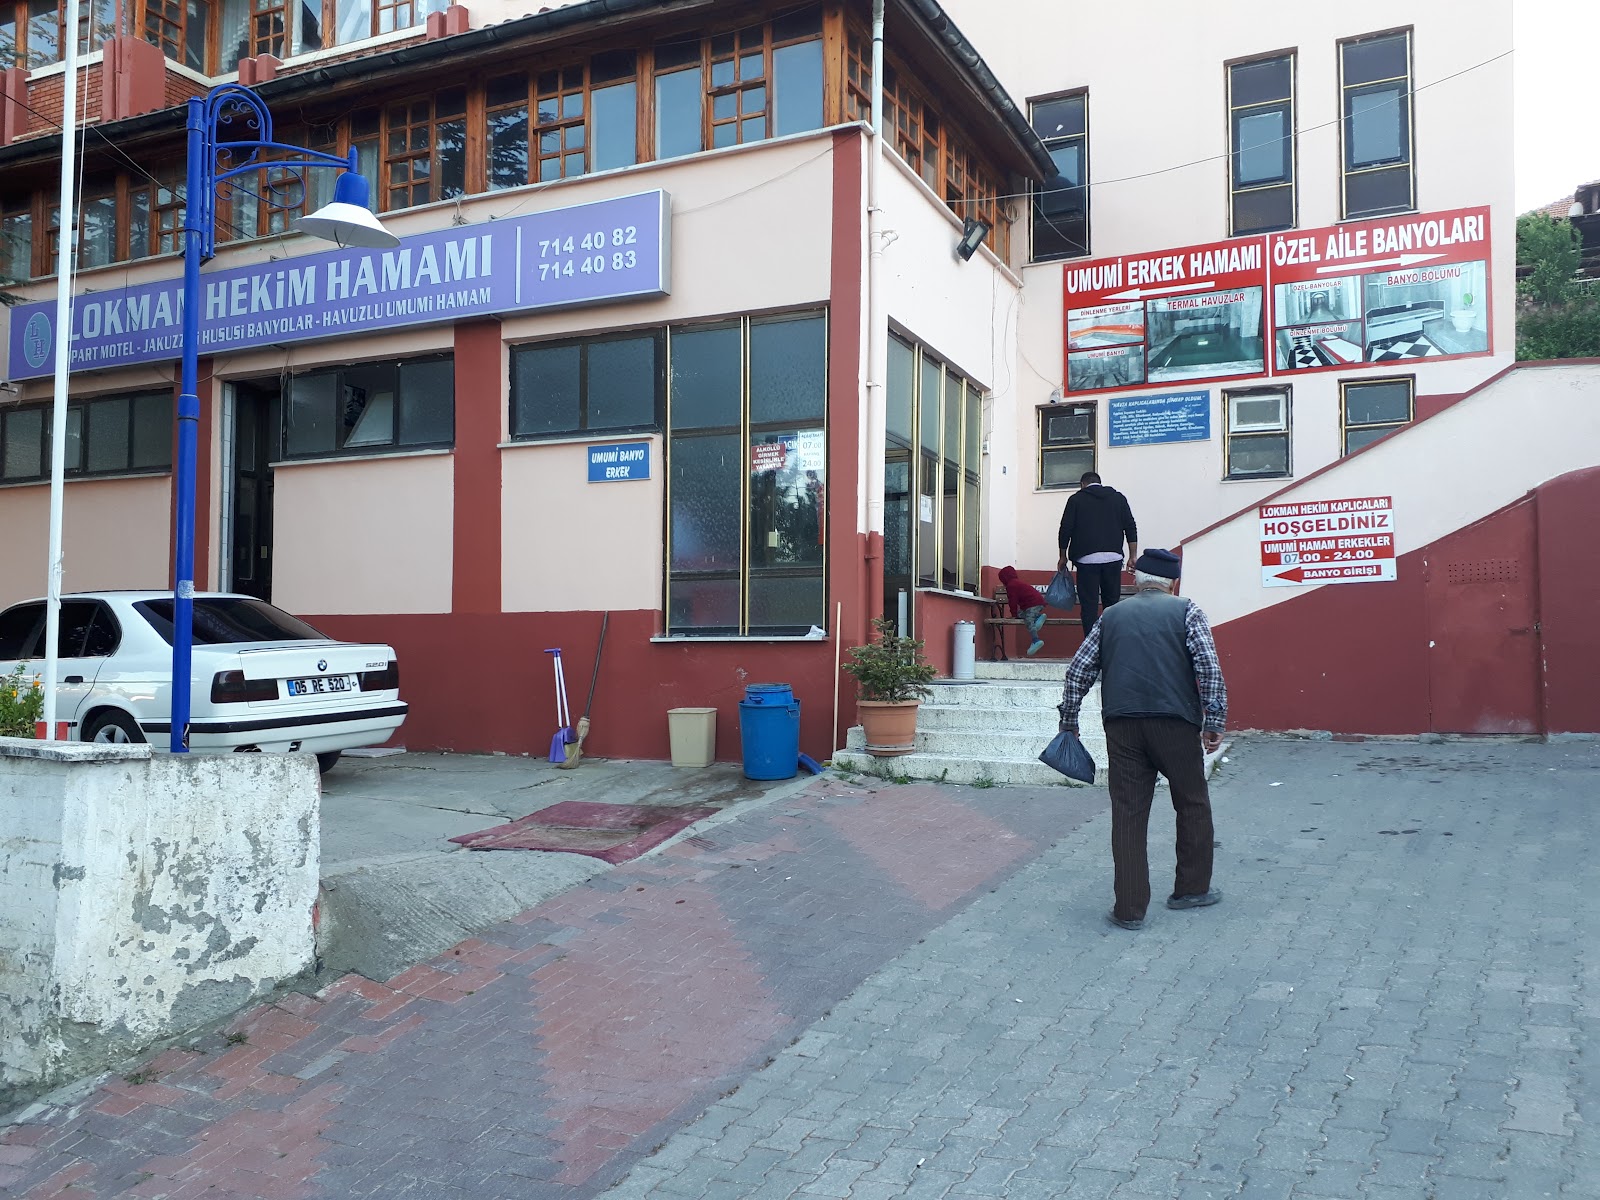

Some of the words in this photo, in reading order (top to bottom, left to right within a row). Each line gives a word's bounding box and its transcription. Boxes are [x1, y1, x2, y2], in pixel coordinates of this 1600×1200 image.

[538, 237, 574, 258] 714
[581, 231, 605, 251] 40
[612, 226, 637, 245] 82
[1274, 236, 1321, 266] ÖZEL
[1325, 227, 1367, 260] AİLE
[1373, 214, 1484, 254] BANYOLARI
[326, 234, 492, 301] HAMAMI
[538, 260, 574, 281] 714
[581, 255, 605, 275] 40
[612, 250, 637, 270] 83
[1067, 258, 1122, 294] UMUMİ
[1127, 255, 1185, 286] ERKEK
[1190, 244, 1261, 277] HAMAMI
[1387, 273, 1420, 286] BANYO
[1167, 299, 1199, 311] TERMAL
[1201, 292, 1245, 307] HAVUZLAR
[1080, 307, 1107, 316] DİNLENME
[71, 346, 98, 363] PART
[100, 341, 135, 360] MOTEL
[247, 317, 313, 339] BANYOLAR
[322, 303, 383, 327] HAVUZLU
[436, 287, 491, 311] HAMAM
[591, 447, 618, 464] UMUMİ
[620, 449, 644, 462] BANYO
[605, 466, 631, 479] ERKEK
[1262, 506, 1298, 518] LOKMAN
[1300, 502, 1328, 515] HEKİM
[1264, 512, 1389, 538] HOŞGELDİNİZ
[1264, 540, 1297, 554] UMUMİ
[1300, 540, 1336, 551] HAMAM
[1338, 536, 1390, 549] ERKEKLER
[1283, 552, 1320, 564] 07.00
[1333, 549, 1374, 561] 24.00
[1303, 568, 1340, 579] BANYO
[1343, 565, 1377, 576] GİRİŞİ
[294, 681, 308, 694] 05
[311, 679, 325, 693] RE
[327, 677, 345, 691] 520
